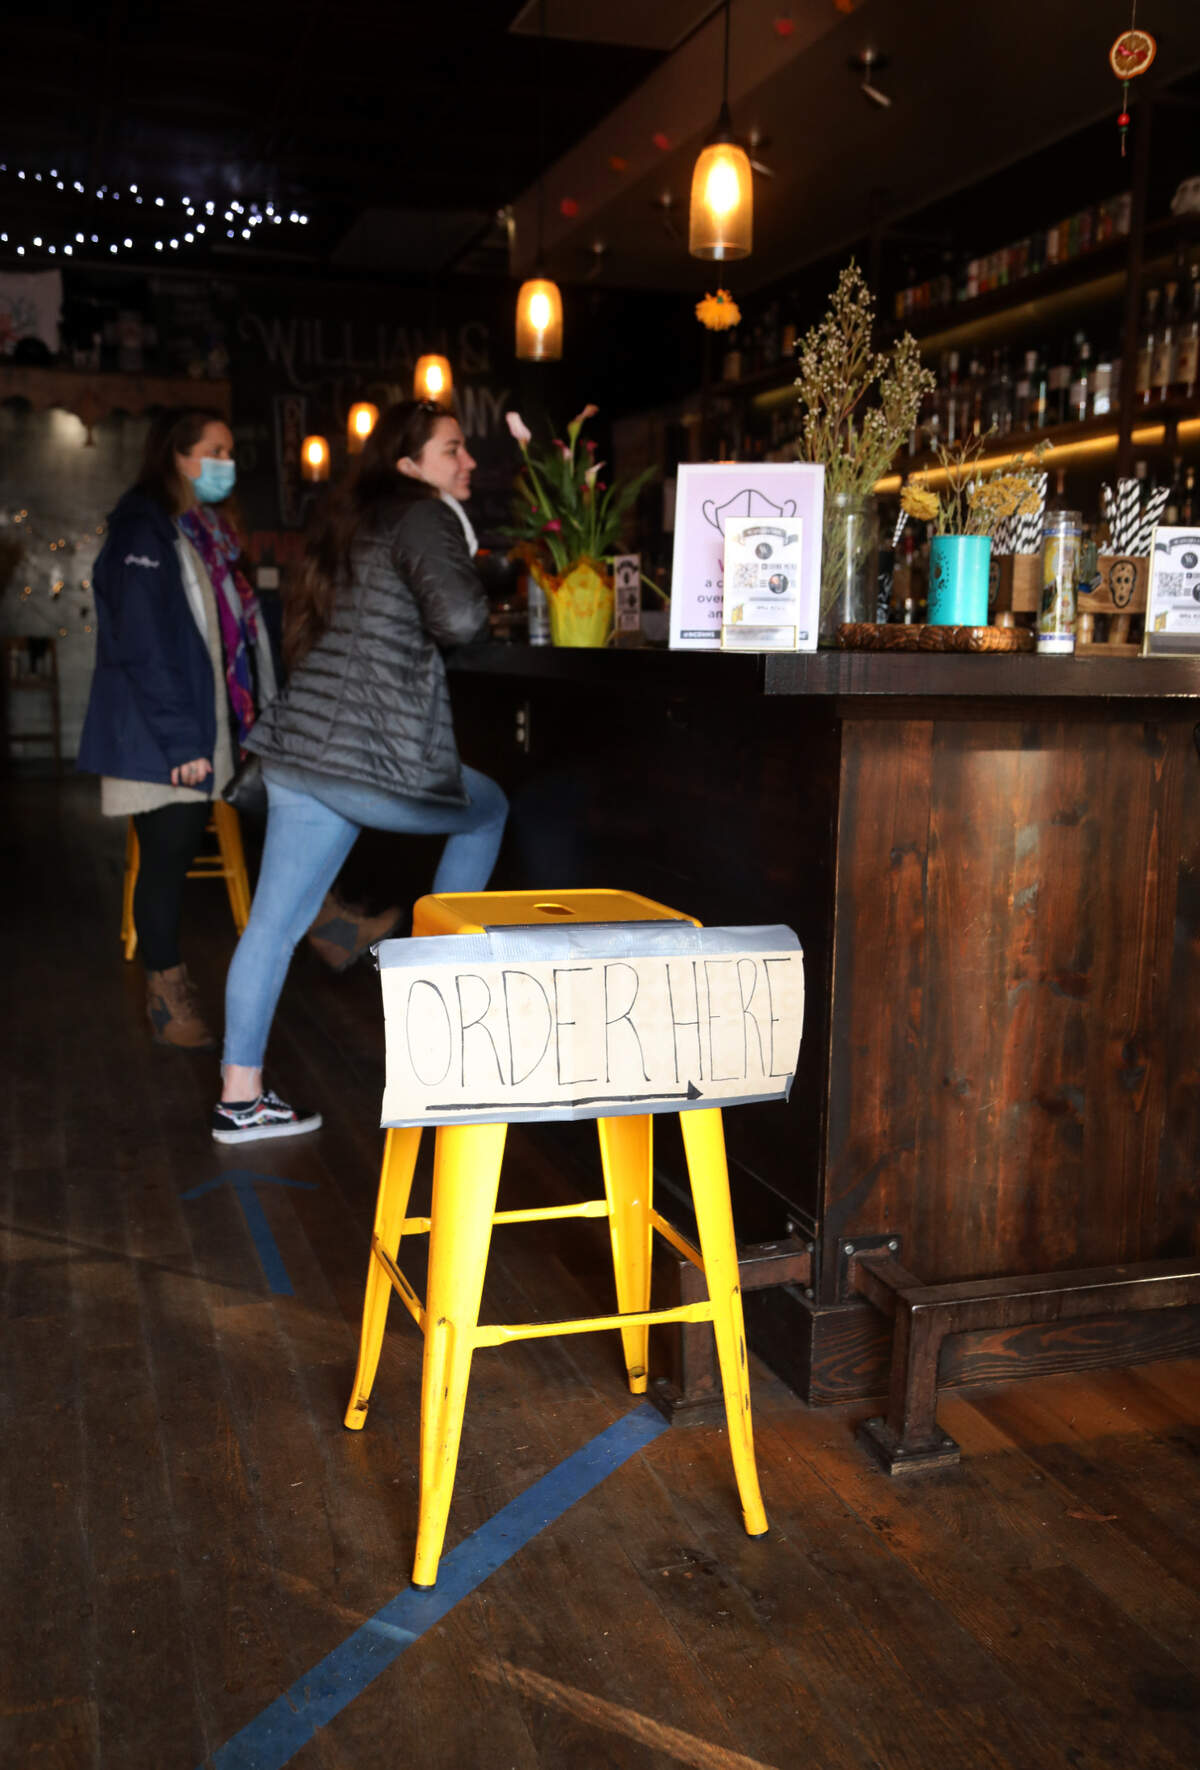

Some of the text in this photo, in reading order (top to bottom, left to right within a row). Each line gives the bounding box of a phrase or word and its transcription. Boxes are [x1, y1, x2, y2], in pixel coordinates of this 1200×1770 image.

[708, 610, 723, 619] an
[406, 958, 794, 1088] ORDER HERE
